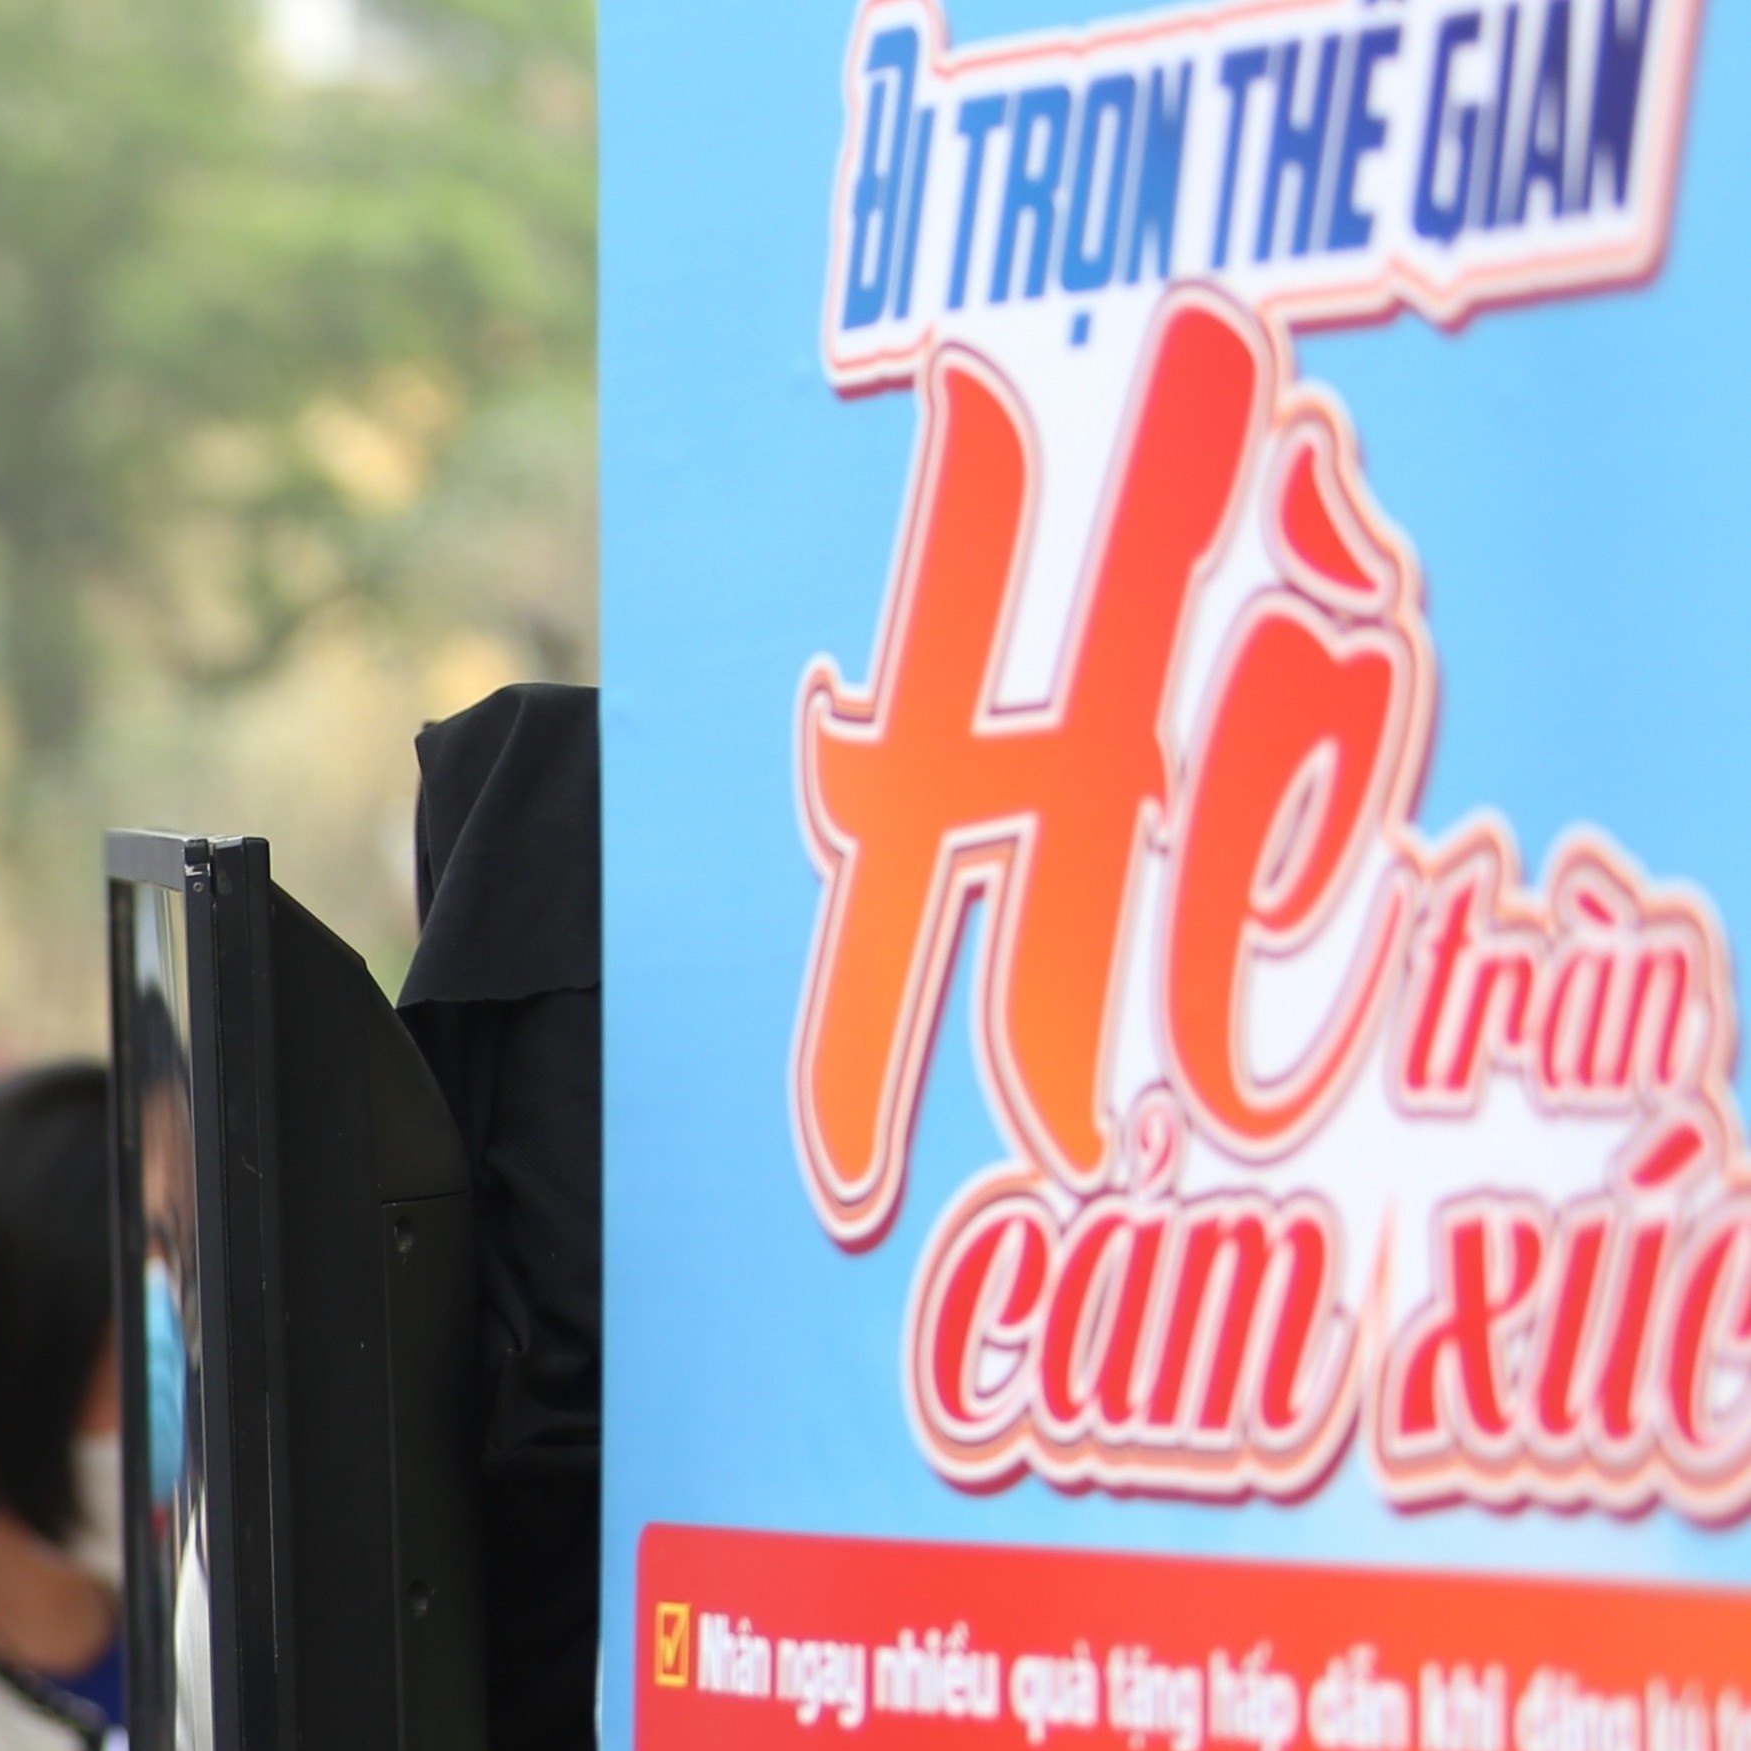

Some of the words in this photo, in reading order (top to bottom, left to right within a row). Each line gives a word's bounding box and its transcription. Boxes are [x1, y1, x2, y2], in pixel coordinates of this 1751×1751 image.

[945, 58, 1195, 347] TRỌN
[1412, 0, 1654, 244] GIAN
[808, 302, 1406, 1190] Hè
[1395, 874, 1692, 1092] tràn
[930, 1110, 1330, 1433] cảm
[776, 1636, 866, 1730] ngay
[1009, 1638, 1099, 1746] quà
